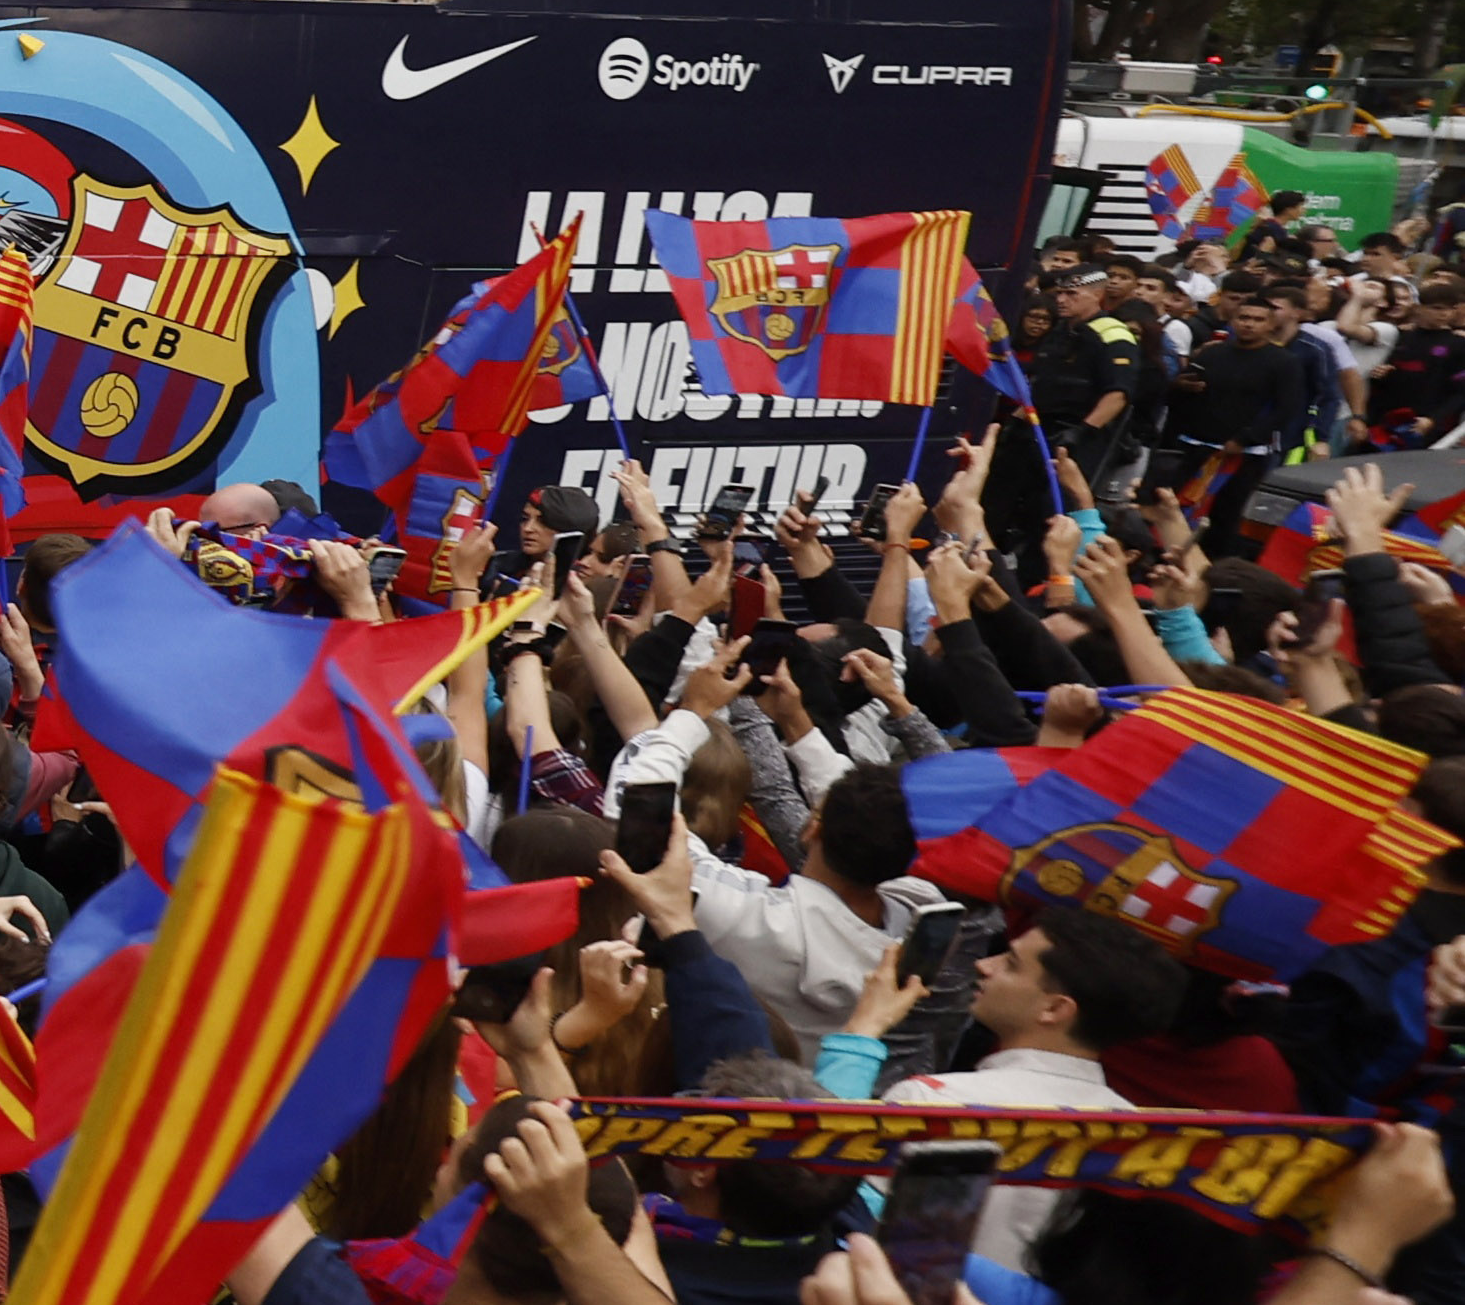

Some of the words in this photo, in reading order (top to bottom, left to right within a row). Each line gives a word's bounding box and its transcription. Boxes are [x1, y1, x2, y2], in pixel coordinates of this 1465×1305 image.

[653, 54, 756, 91] Spotify
[872, 65, 1012, 85] CUPRA
[91, 308, 181, 360] FCB
